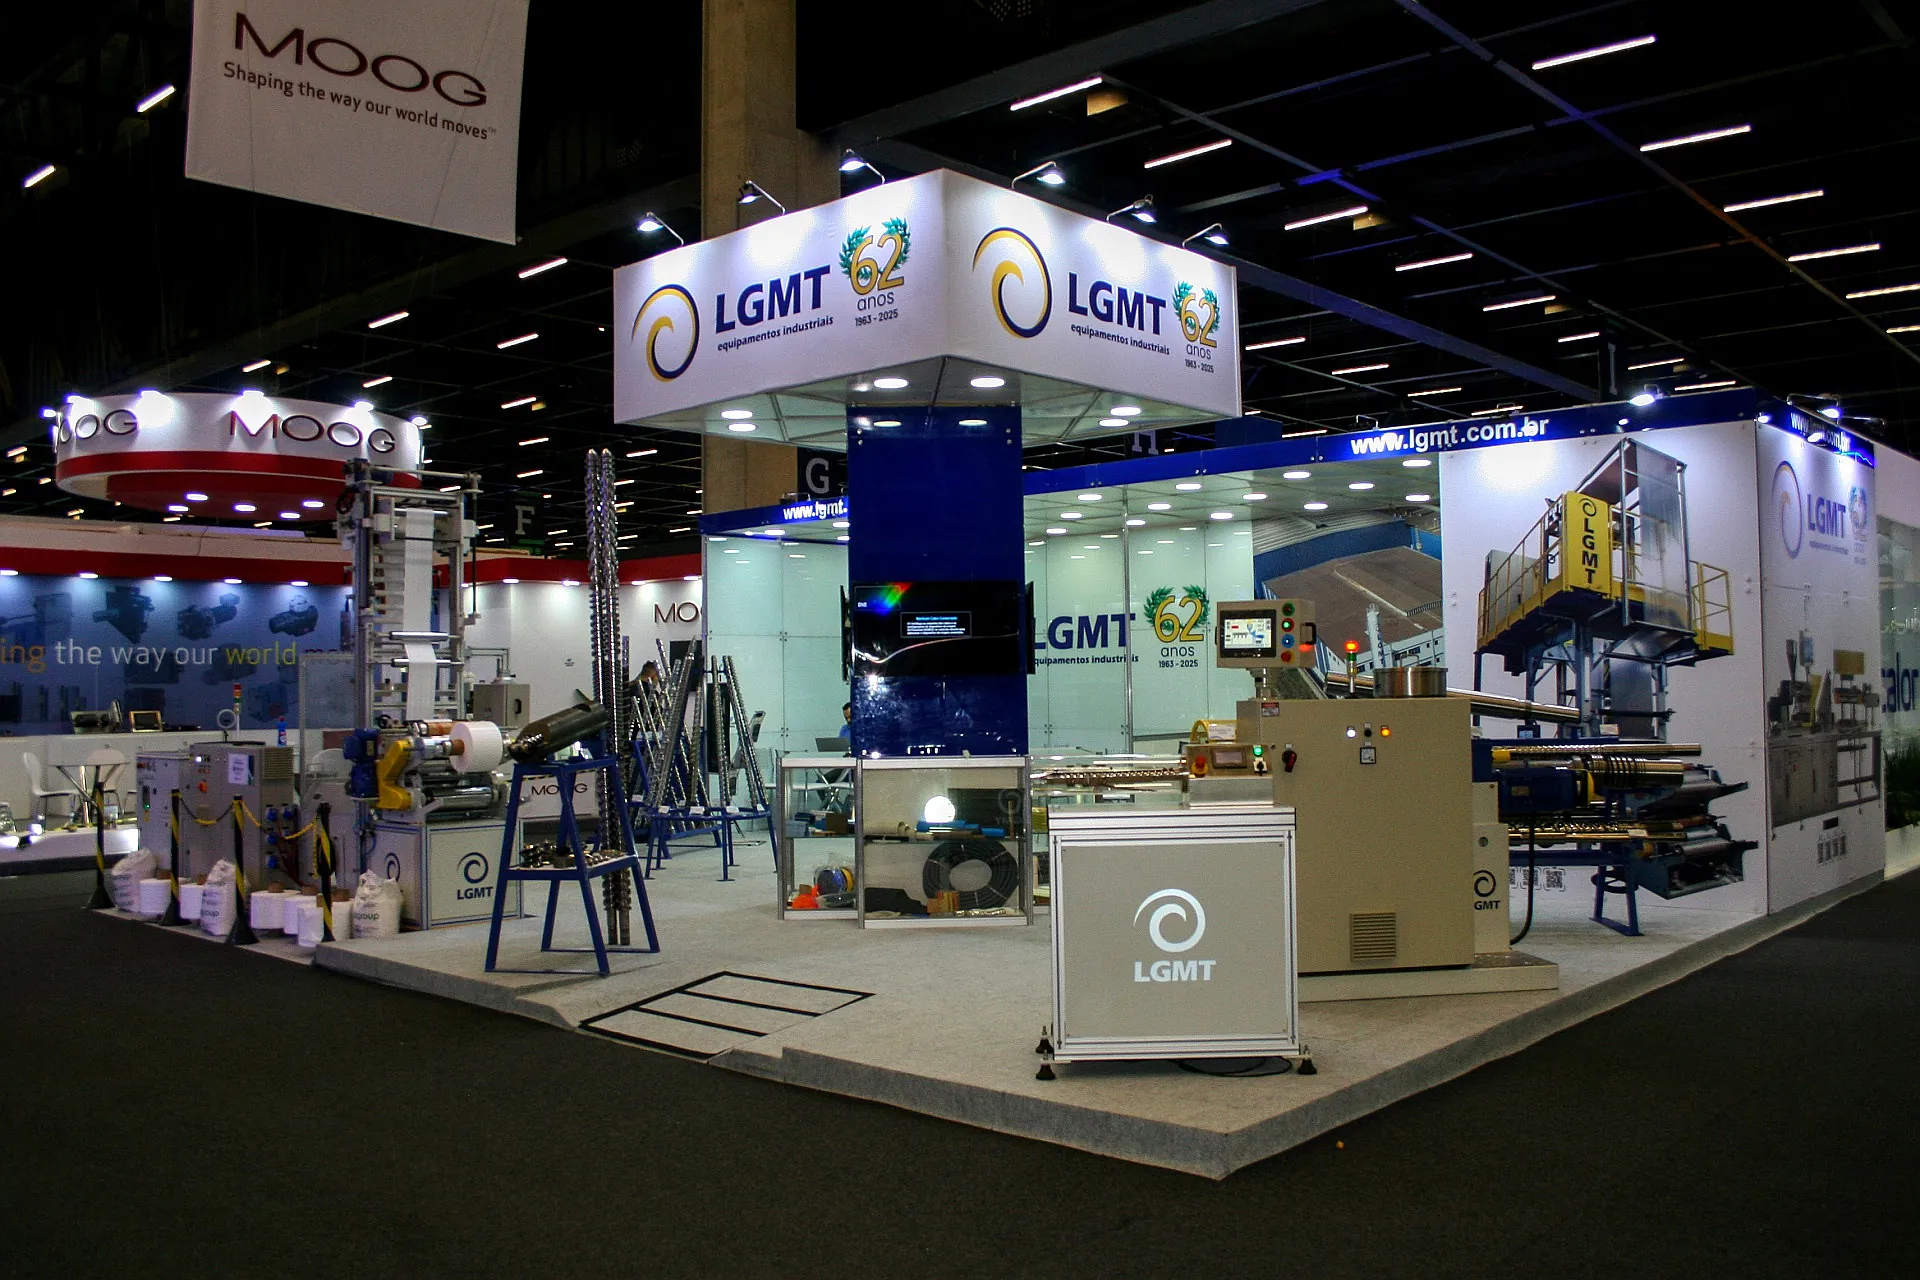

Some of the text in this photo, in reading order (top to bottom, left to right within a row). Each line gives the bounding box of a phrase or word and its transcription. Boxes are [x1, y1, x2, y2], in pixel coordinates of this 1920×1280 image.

[235, 12, 487, 107] MOOG
[224, 61, 294, 97] Shaping
[298, 82, 325, 100] the
[331, 91, 361, 112] way
[366, 100, 392, 116] our
[396, 107, 438, 128] world
[850, 233, 905, 295] 62
[716, 264, 831, 334] LGMT
[857, 291, 895, 312] anos
[1068, 272, 1166, 336] LGMT
[717, 315, 834, 352] equipamentos industriais
[855, 314, 872, 327] 1963
[879, 308, 899, 321] 2025
[1180, 293, 1217, 348] 62
[1071, 323, 1170, 355] equipamentos industriais
[1187, 343, 1212, 360] anos
[59, 409, 138, 444] OOG
[229, 410, 396, 453] MOOG
[1350, 416, 1549, 454] www.lgmt.com.br
[806, 457, 830, 494] G
[515, 505, 535, 535] F
[783, 500, 848, 520] www.lgmt.
[1807, 494, 1846, 538] LGMT
[1582, 517, 1598, 584] LGMT
[654, 602, 702, 623] MO
[1154, 594, 1204, 643] 62
[0, 637, 297, 673] ing the way our world
[1034, 653, 1139, 667] quipamentos industriis
[1159, 660, 1176, 668] 1963
[1180, 660, 1198, 668] 2025
[1160, 645, 1195, 657] anos
[531, 783, 588, 796] MOG
[457, 886, 493, 900] LGMT
[1474, 900, 1500, 910] GMT
[1134, 960, 1217, 982] LGMT
